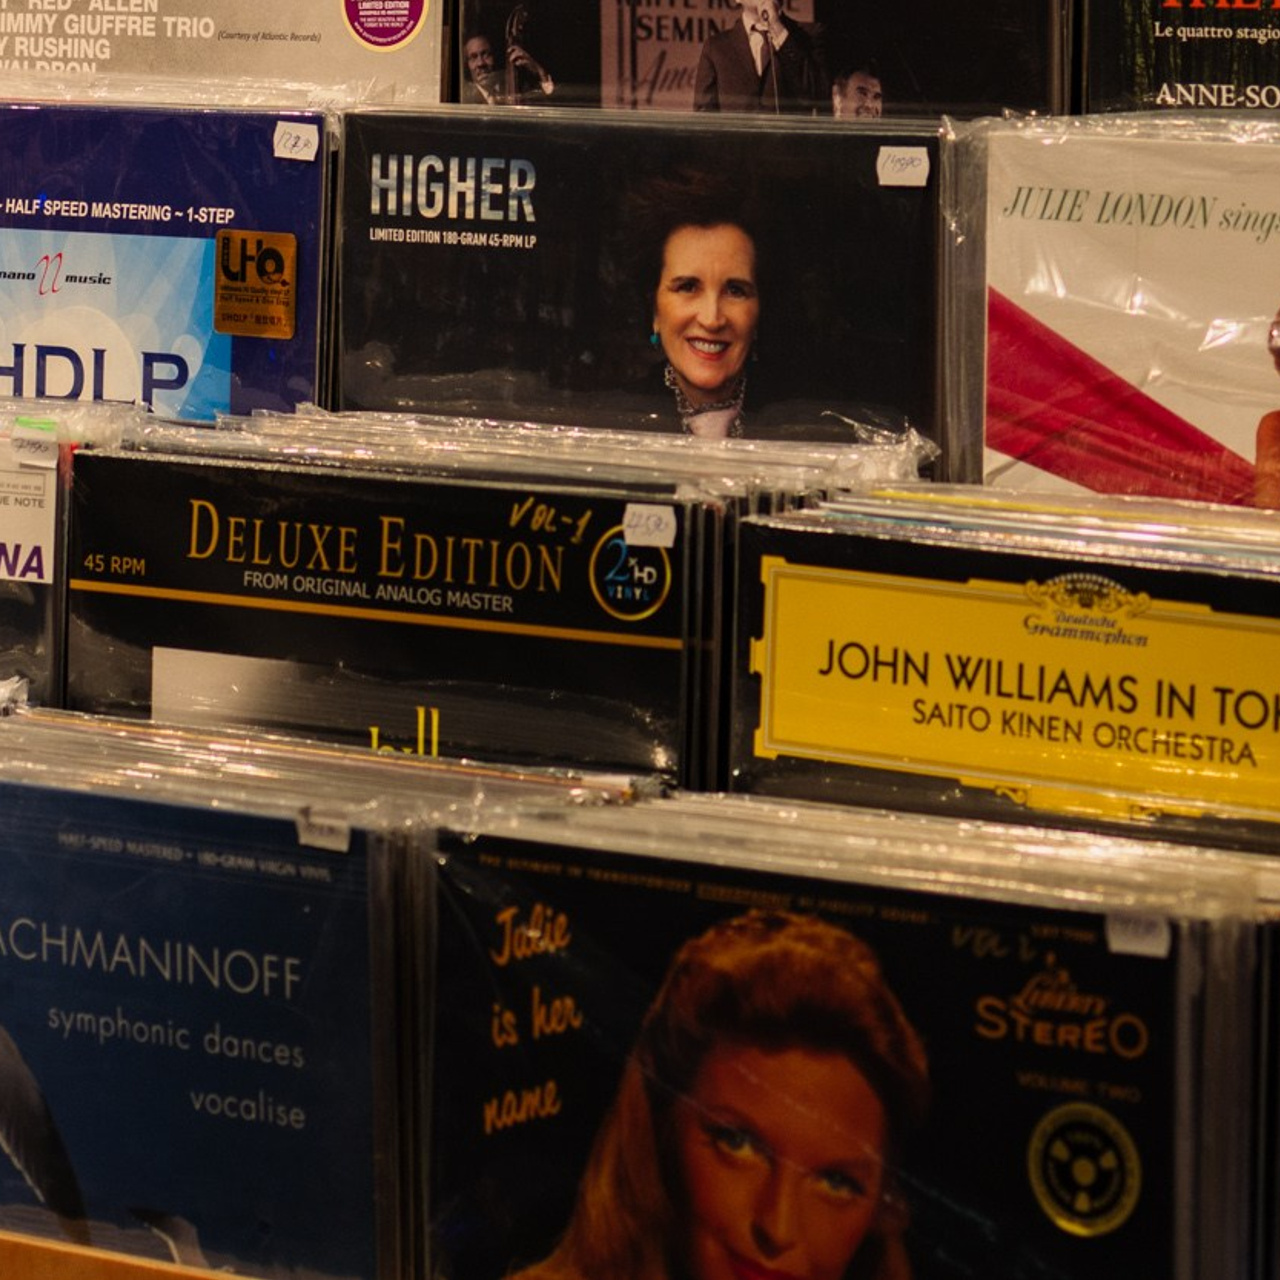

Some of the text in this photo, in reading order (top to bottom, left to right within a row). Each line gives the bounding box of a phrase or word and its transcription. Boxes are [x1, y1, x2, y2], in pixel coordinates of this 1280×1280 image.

[64, 15, 156, 37] GIUFFRE
[163, 17, 215, 38] TRIO
[1155, 21, 1233, 41] Le quattro
[15, 37, 111, 59] RUSHING
[370, 153, 537, 222] HIGHER
[6, 199, 41, 214] HALF
[43, 200, 89, 217] SPEED
[92, 202, 172, 221] MASTERING
[186, 207, 235, 224] 1-STEP
[1003, 186, 1091, 222] JULIE
[1095, 190, 1219, 229] LONDON
[369, 227, 537, 249] LIMITED EDITION 180-GRAM 45-RPM LP
[65, 272, 112, 286] music
[14, 496, 46, 509] NOTE
[84, 554, 146, 575] 45 RPM
[244, 571, 514, 613] FROM ORIGINAL ANALOG MASTER
[607, 587, 650, 601] VINYL
[1023, 614, 1149, 647] Grammophon
[1057, 610, 1118, 629] Deutsche
[818, 639, 1196, 720] JOHN WILLIAMS IN
[912, 699, 1258, 767] SAITO KINEN ORCHESTRA
[490, 901, 572, 967] Julie
[491, 983, 585, 1049] is her
[49, 1005, 305, 1068] symphonic dances
[190, 1089, 305, 1129] vocalise
[484, 1079, 562, 1135] name
